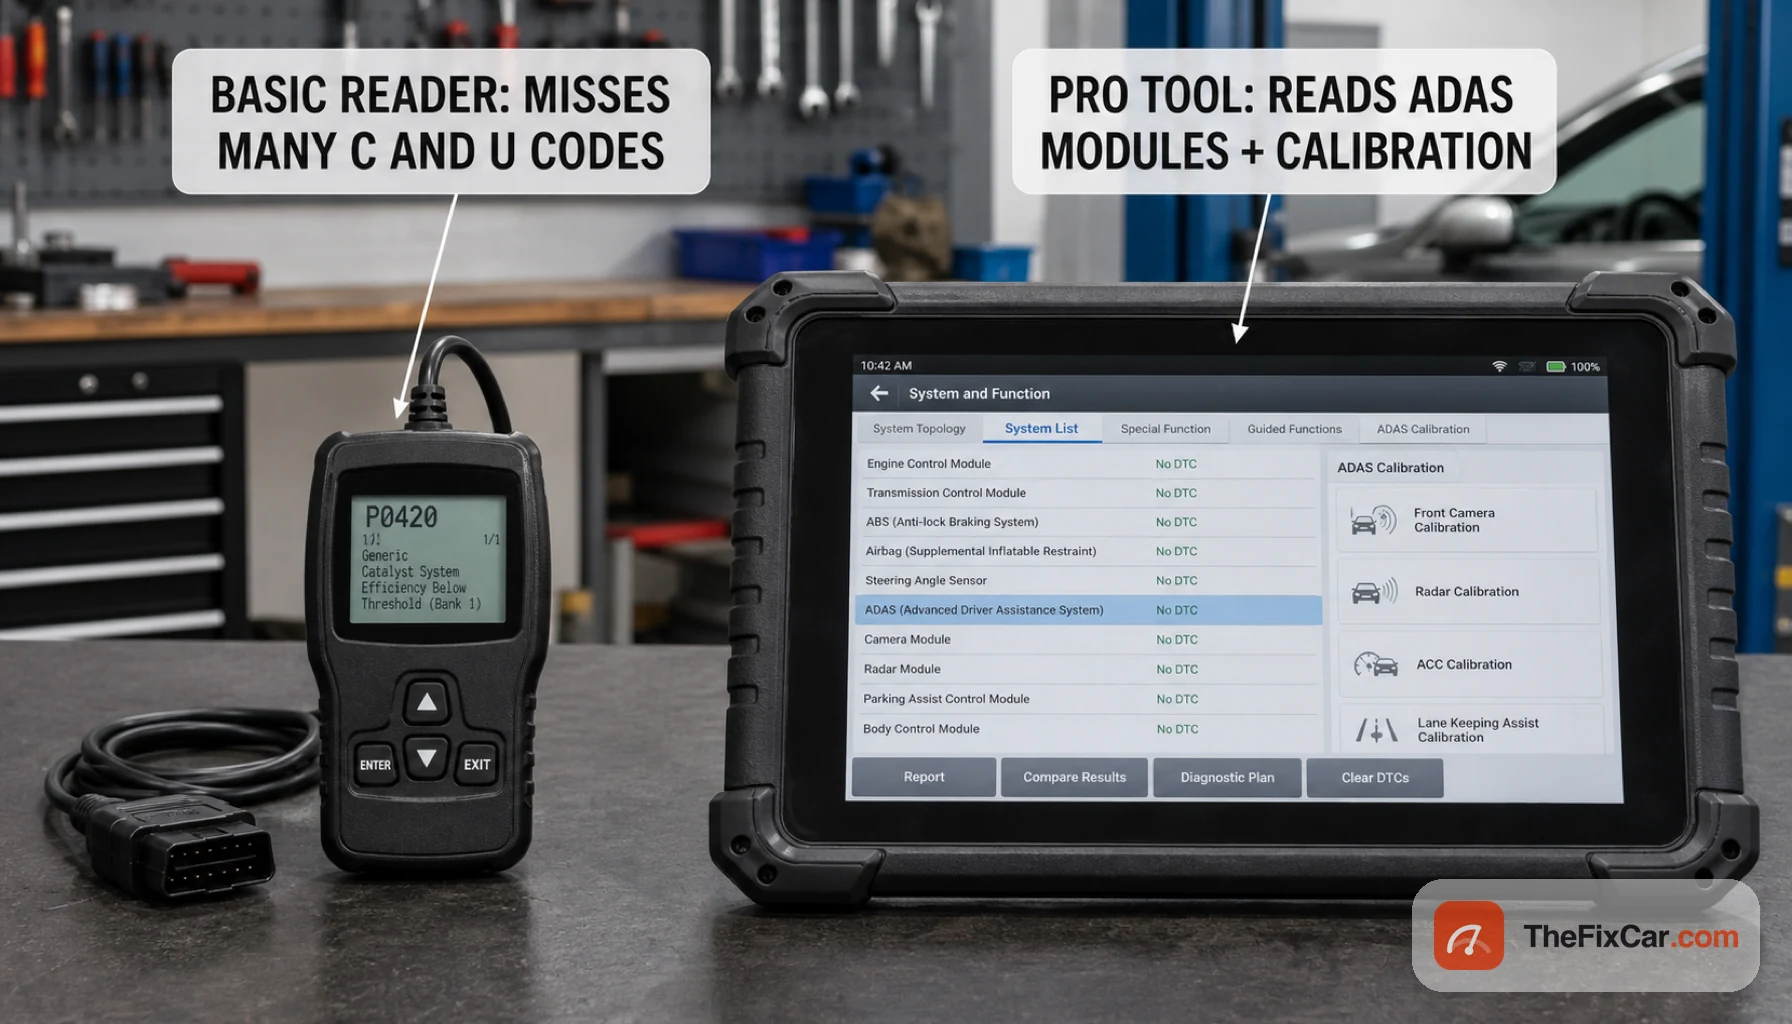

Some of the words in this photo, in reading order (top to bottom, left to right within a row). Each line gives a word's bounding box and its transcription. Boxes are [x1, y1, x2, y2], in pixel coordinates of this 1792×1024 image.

[861, 361, 890, 370] 10:42
[894, 361, 912, 370] AM
[1572, 362, 1600, 372] 100%
[910, 388, 959, 403] System
[963, 388, 987, 399] and
[992, 388, 1050, 399] Function
[874, 423, 913, 435] System
[917, 424, 966, 435] Topology
[1006, 423, 1051, 436] System
[1056, 423, 1078, 433] List
[1121, 424, 1160, 435] Special
[1164, 424, 1211, 433] Function
[1248, 424, 1285, 433] Guided
[1290, 424, 1342, 433] Functions
[1377, 424, 1408, 433] ADAS
[1411, 424, 1469, 434] Calibration
[868, 459, 904, 470] Engine
[907, 459, 947, 468] Control
[951, 459, 991, 468] Module
[1156, 459, 1171, 469] No
[1174, 459, 1197, 469] DTC
[1338, 462, 1373, 472] ADAS
[1377, 462, 1444, 473] Calibration
[867, 488, 939, 497] Transmission
[943, 488, 982, 497] Control
[986, 488, 1026, 498] Module
[1156, 488, 1171, 498] No
[1174, 488, 1197, 498] DTC
[366, 504, 438, 528] P0420
[1415, 508, 1445, 518] Front
[1449, 508, 1495, 517] Camera
[866, 517, 889, 526] ABS
[893, 517, 945, 528] (Anti-lock
[949, 517, 990, 528] Braking
[994, 517, 1038, 528] System)
[1157, 517, 1171, 527] No
[1175, 517, 1197, 527] DTC
[1415, 522, 1479, 532] Calibration
[484, 533, 500, 545] 1/1
[362, 549, 408, 561] Generic
[866, 546, 902, 558] Airbag
[905, 546, 985, 558] (Supplemental
[989, 546, 1040, 555] Inflatable
[1043, 546, 1096, 557] Restraint)
[1157, 547, 1171, 556] No
[1175, 546, 1197, 556] DTC
[362, 565, 414, 579] Catalyst
[420, 565, 459, 579] System
[866, 576, 911, 587] Steering
[915, 576, 946, 587] Angle
[949, 576, 987, 585] Sensor
[1157, 576, 1171, 585] No
[1175, 576, 1197, 585] DTC
[362, 581, 426, 596] Efficiency
[433, 581, 466, 593] Below
[1416, 586, 1451, 596] Radar
[1454, 586, 1519, 596] Calibration
[362, 597, 421, 609] Threshold
[430, 597, 461, 611] (Bank
[470, 598, 481, 611] 1)
[865, 605, 896, 615] ADAS
[900, 605, 957, 616] (Advanced
[961, 605, 993, 615] Driver
[996, 605, 1056, 615] Assistance
[1059, 605, 1103, 617] System)
[1157, 606, 1171, 615] No
[1175, 605, 1197, 615] DTC
[865, 634, 906, 644] Camera
[911, 634, 951, 644] Module
[1157, 635, 1172, 644] No
[1175, 634, 1198, 645] DTC
[865, 664, 897, 674] Radar
[900, 664, 941, 674] Module
[1157, 665, 1172, 674] No
[1176, 664, 1198, 674] DTC
[1417, 659, 1443, 670] ACC
[1447, 659, 1512, 670] Calibration
[864, 694, 905, 706] Parking
[908, 694, 942, 703] Assist
[945, 694, 985, 703] Control
[989, 694, 1030, 703] Module
[1157, 694, 1172, 704] No
[1176, 694, 1198, 704] DTC
[1158, 724, 1172, 734] No
[1176, 724, 1198, 734] DTC
[1418, 718, 1447, 728] Lane
[1451, 717, 1498, 730] Keeping
[1502, 717, 1539, 728] Assist
[864, 724, 891, 736] Body
[894, 724, 935, 733] Control
[939, 724, 980, 734] Module
[1418, 732, 1483, 742] Calibration
[361, 760, 391, 770] ENTER
[465, 759, 491, 770] EXIT
[905, 771, 944, 784] Report
[1024, 772, 1078, 784] Compare
[1082, 772, 1126, 782] Results
[1182, 772, 1245, 785] Diagnostic
[1249, 772, 1274, 782] Plan
[1342, 772, 1374, 783] Clear
[1377, 772, 1409, 783] DTCs
